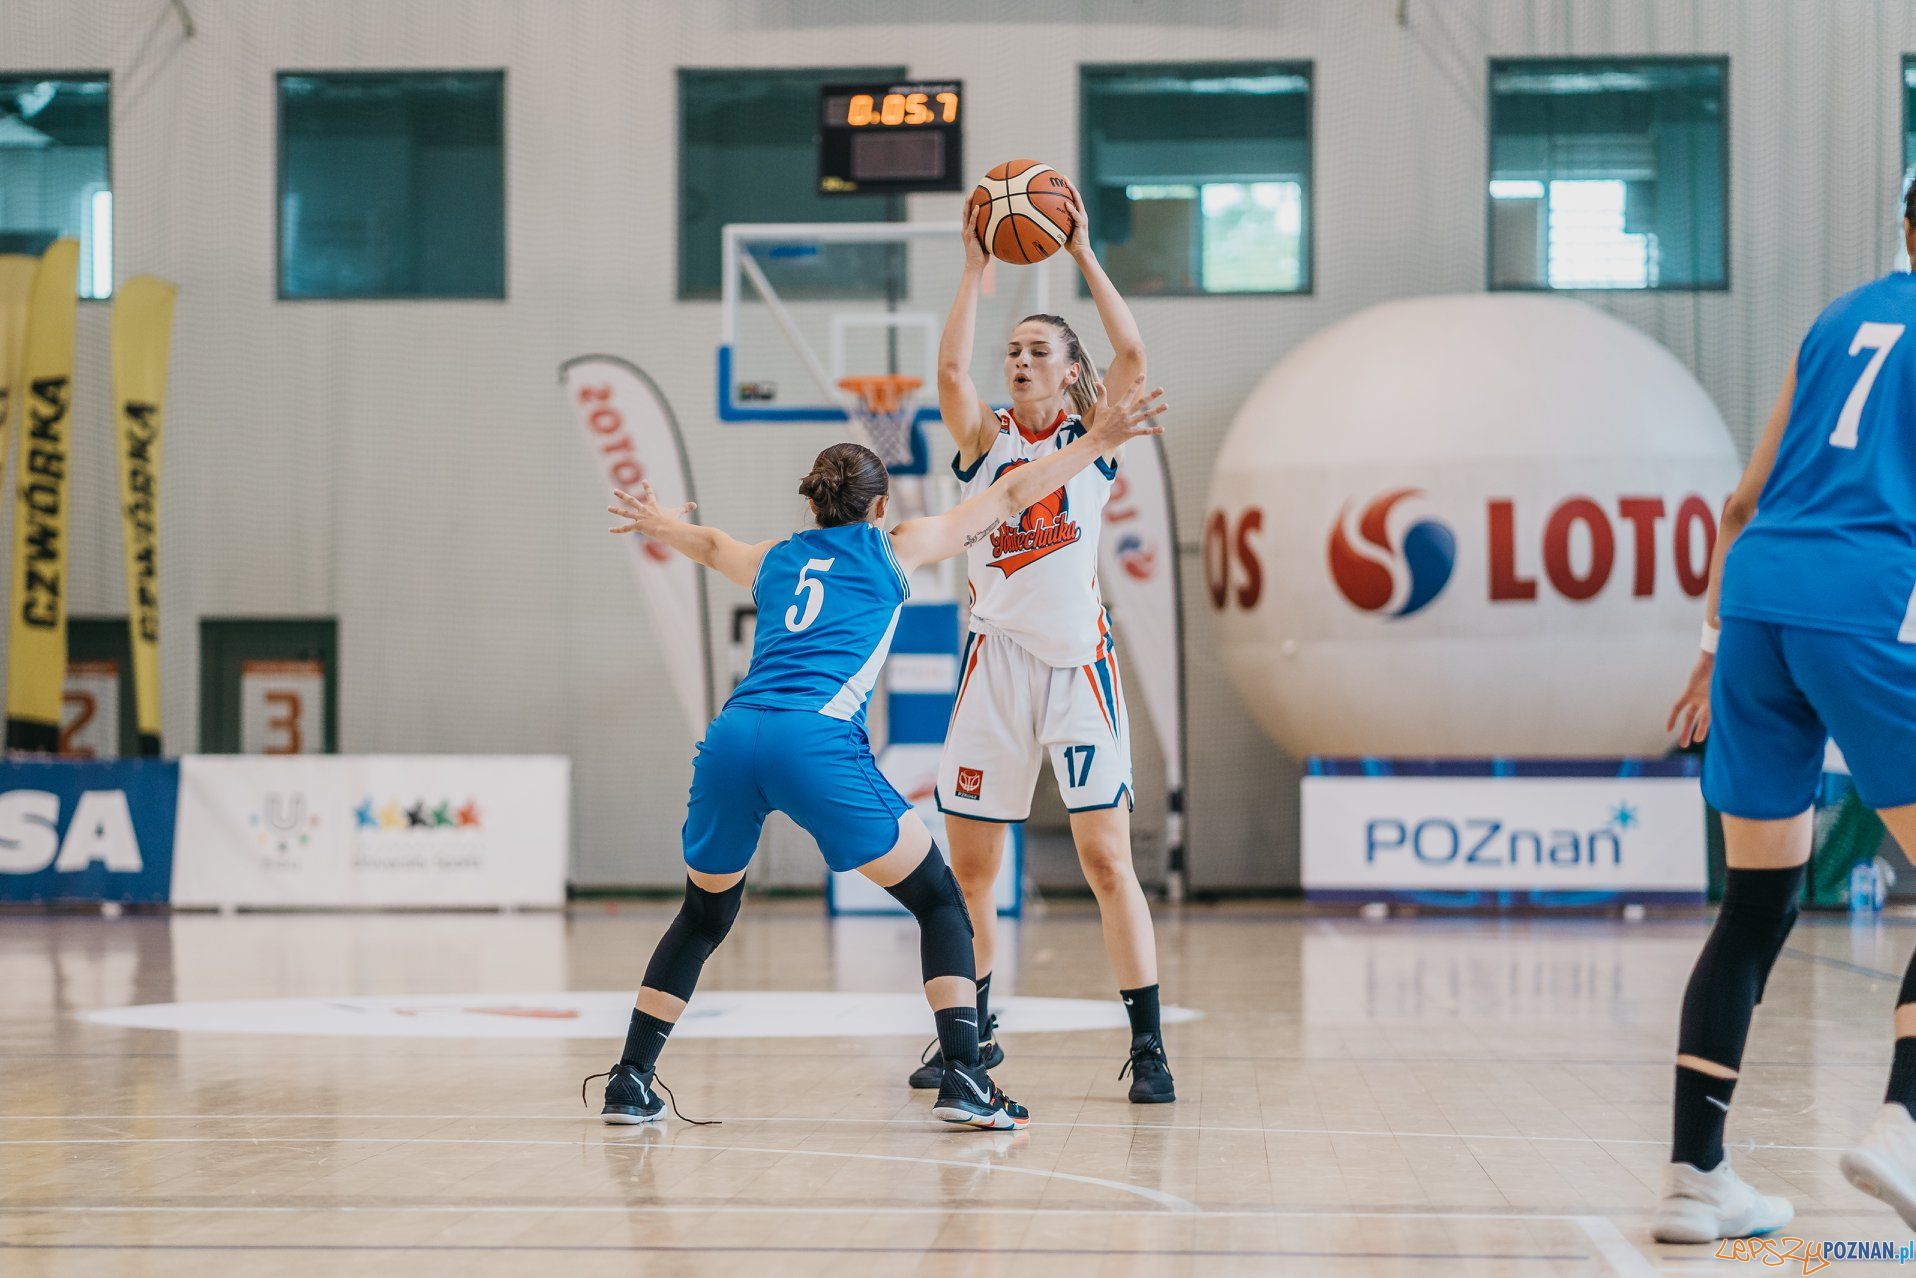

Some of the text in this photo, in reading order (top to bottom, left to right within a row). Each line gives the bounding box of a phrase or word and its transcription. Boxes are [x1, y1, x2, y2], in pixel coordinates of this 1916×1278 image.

[1828, 321, 1906, 450] 7
[16, 374, 70, 630] CZWÓRKA
[784, 557, 836, 632] 5
[1486, 494, 1733, 605] LOTO
[264, 690, 303, 757] 3
[1063, 744, 1096, 788] 17
